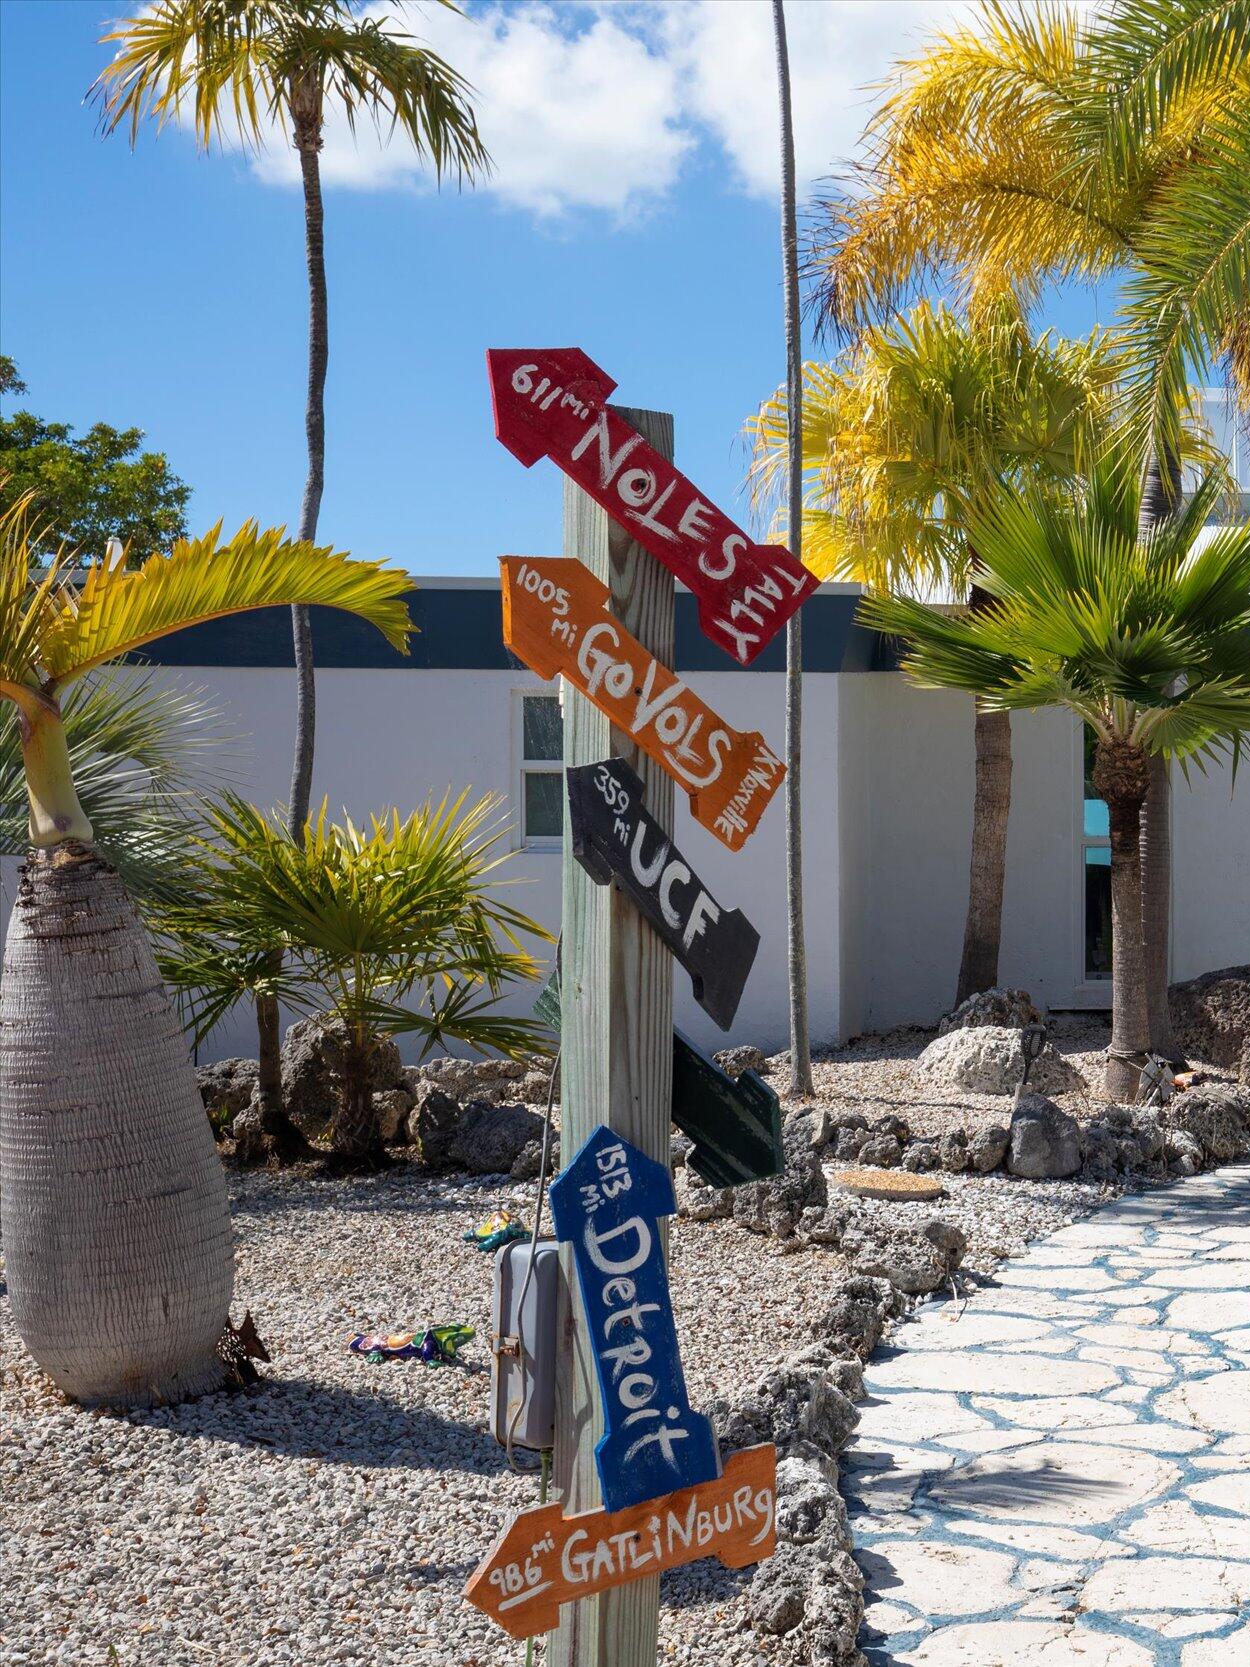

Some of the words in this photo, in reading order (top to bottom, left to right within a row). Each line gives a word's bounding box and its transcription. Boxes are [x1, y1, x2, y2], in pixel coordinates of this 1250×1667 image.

[511, 363, 563, 412] 611
[571, 412, 748, 581] NOLES
[516, 564, 571, 616] 1005
[712, 564, 808, 665] TALLY
[593, 765, 630, 816] 359
[630, 819, 720, 950] UCF
[595, 1143, 633, 1199] 1513
[489, 1557, 542, 1597] 986
